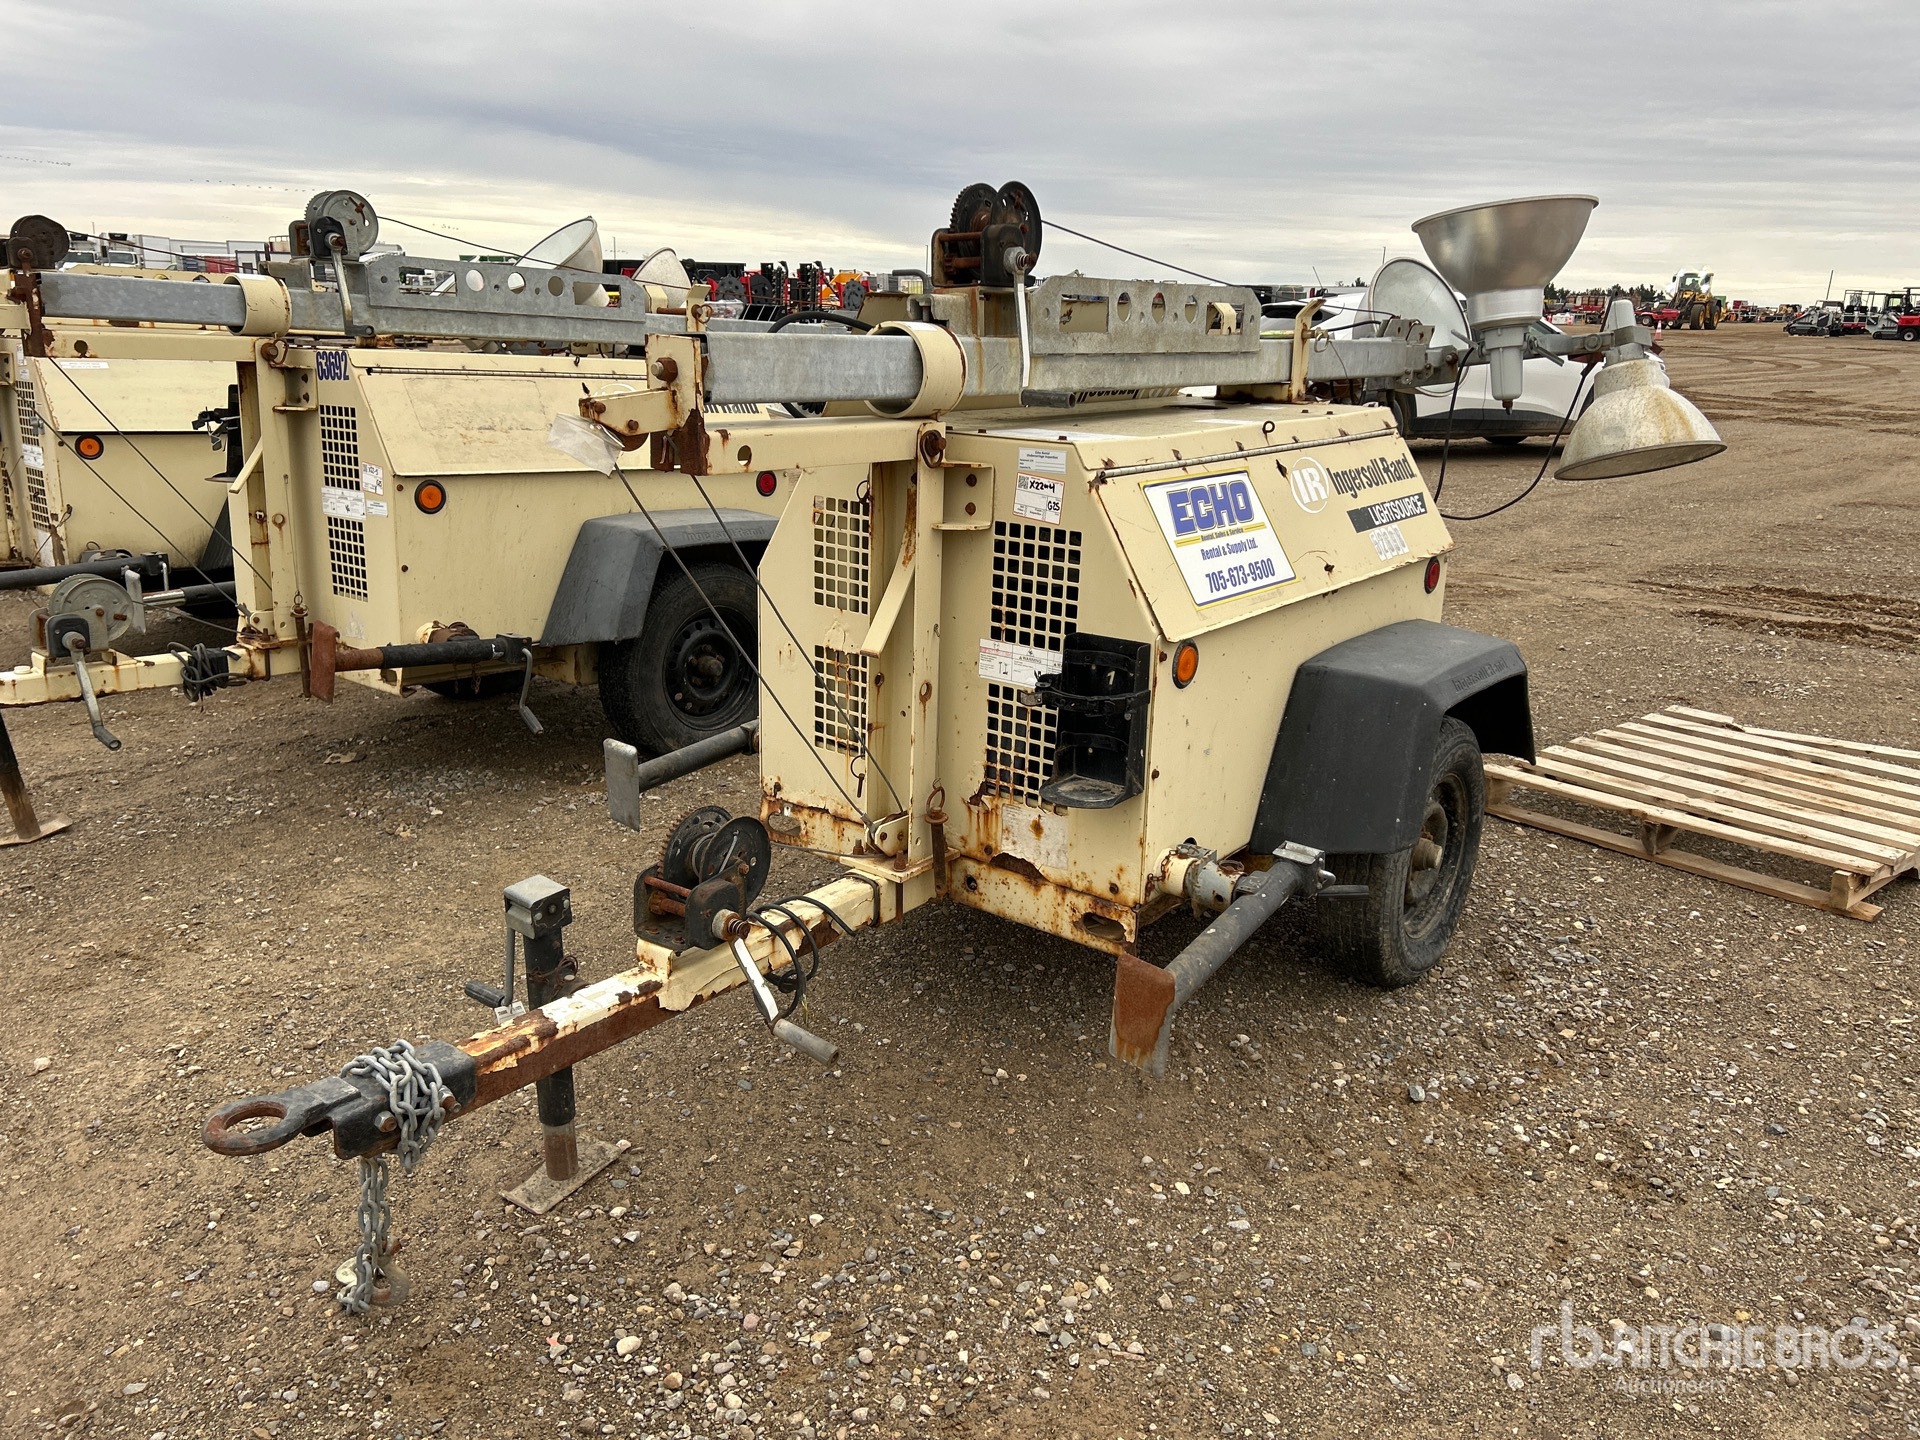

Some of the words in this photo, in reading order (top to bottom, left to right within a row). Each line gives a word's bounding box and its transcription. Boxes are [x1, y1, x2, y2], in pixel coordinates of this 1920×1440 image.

[316, 350, 350, 381] 63692
[1291, 467, 1329, 505] IR
[1166, 480, 1255, 537] ECHO
[1367, 494, 1426, 526] LIGHTSOURCE
[1200, 545, 1222, 560] Rental
[1222, 545, 1228, 556] &
[1226, 540, 1248, 555] Supply
[1246, 537, 1259, 550] Ltd.
[1205, 558, 1276, 593] 705-673-9500
